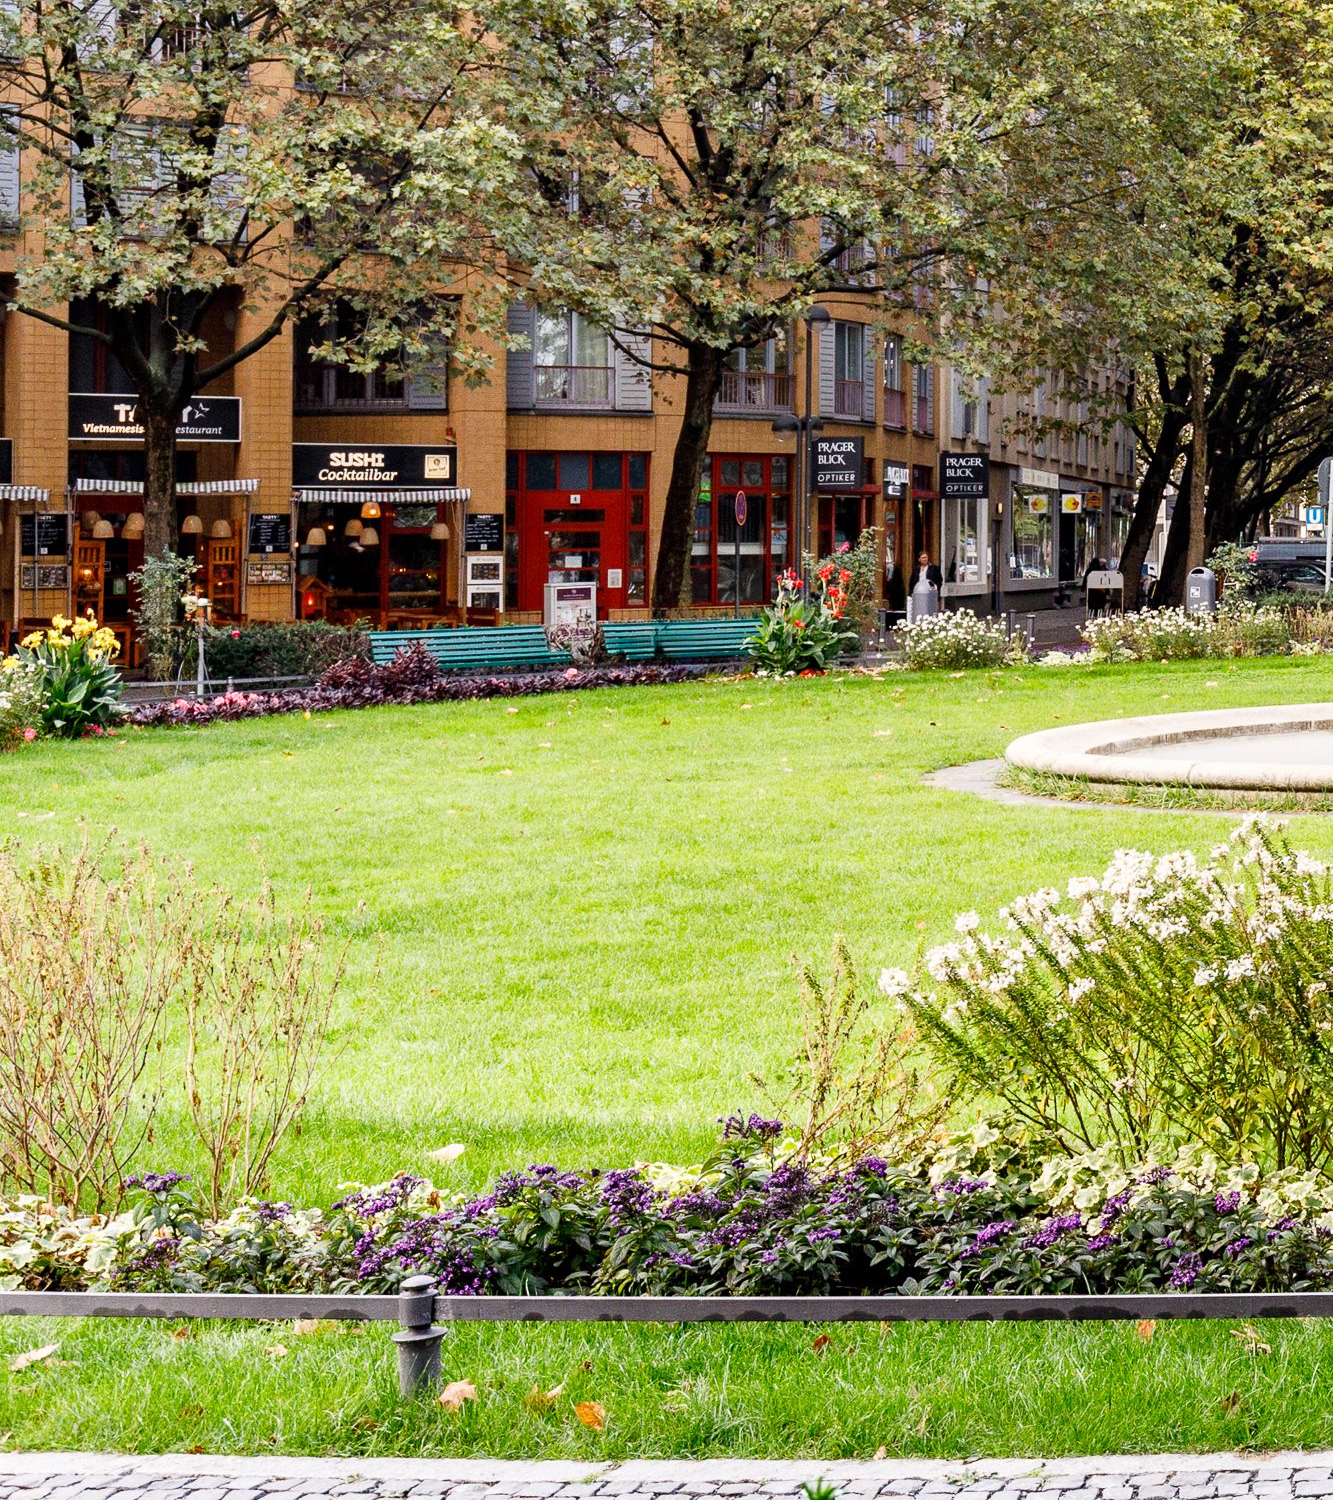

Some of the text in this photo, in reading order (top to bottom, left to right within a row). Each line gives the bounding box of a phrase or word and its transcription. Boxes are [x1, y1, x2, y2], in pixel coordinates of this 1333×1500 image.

[82, 423, 222, 435] Vietnamesis estaurant
[818, 442, 856, 452] PRAGER
[329, 452, 385, 467] SUSHI
[818, 454, 846, 465] BLICK
[946, 457, 984, 467] PRAGER
[318, 468, 398, 481] Cocktailbar
[818, 473, 856, 482] OPTIKER
[946, 468, 974, 478] BLICK
[1308, 509, 1320, 524] U
